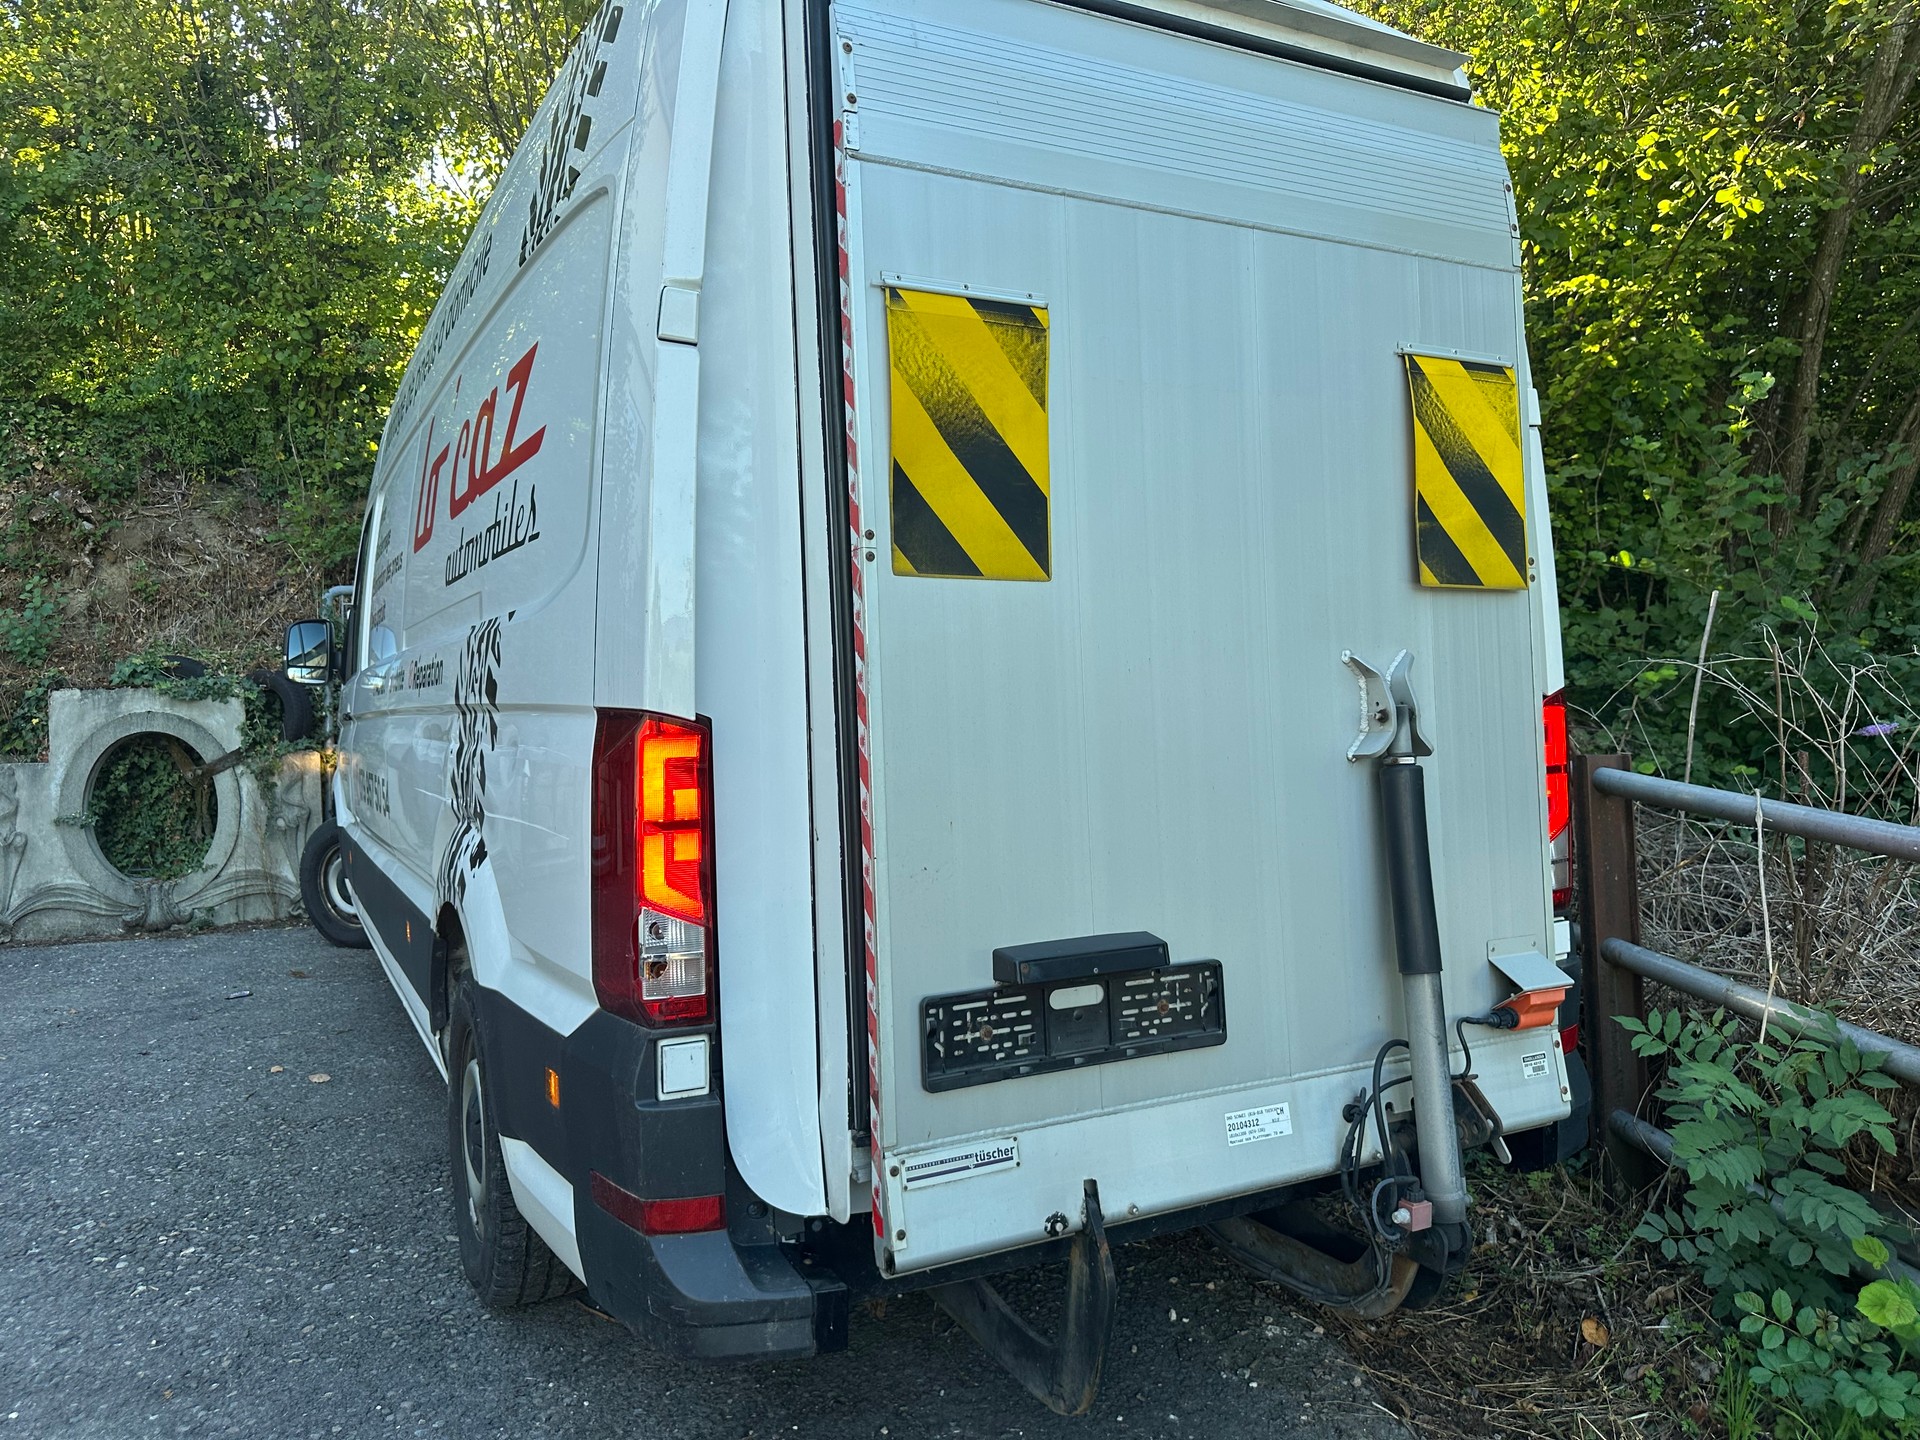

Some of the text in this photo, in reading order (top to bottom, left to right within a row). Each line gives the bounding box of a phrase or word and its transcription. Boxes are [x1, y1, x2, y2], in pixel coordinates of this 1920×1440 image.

[445, 231, 493, 341] domicile
[445, 478, 541, 588] automobiles
[413, 652, 444, 698] Réparation
[381, 776, 391, 820] 54
[1227, 1118, 1260, 1132] 20104312
[974, 1146, 1015, 1163] tüscher
